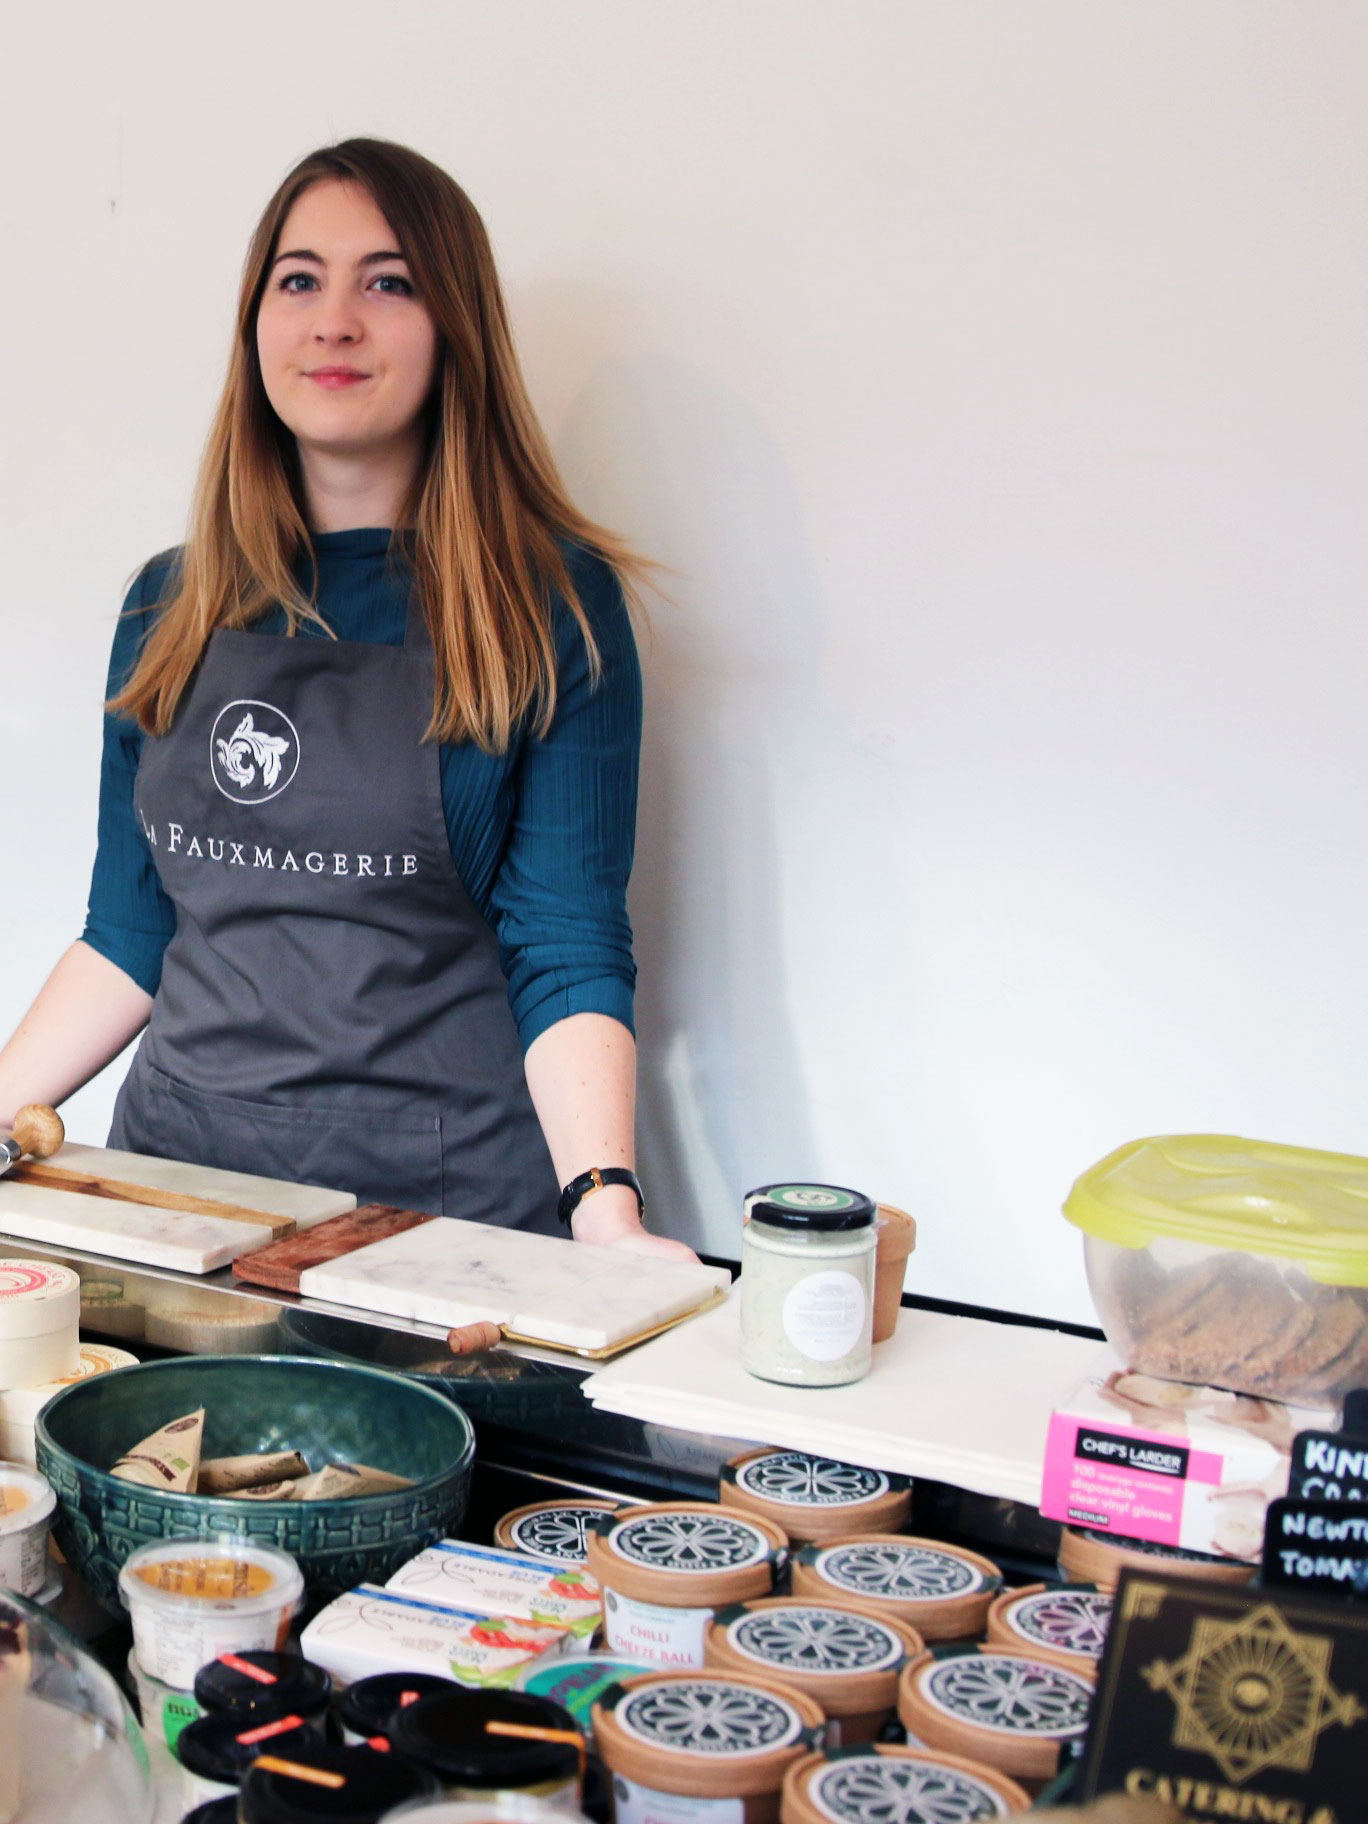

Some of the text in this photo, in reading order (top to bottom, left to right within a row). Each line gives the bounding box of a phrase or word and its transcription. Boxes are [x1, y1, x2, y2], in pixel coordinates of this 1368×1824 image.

[167, 822, 419, 878] FAUXMAGERIE
[1082, 1437, 1182, 1470] CHEF'S LARDER
[1074, 1463, 1096, 1478] 100
[1070, 1478, 1136, 1501] disposable
[1068, 1508, 1109, 1525] MEDIUM
[1069, 1492, 1173, 1524] clear vinyl gloves
[1282, 1511, 1368, 1542] NEWT
[614, 1632, 695, 1665] CHEEZE BALL
[630, 1623, 670, 1644] CHILLI
[1124, 1768, 1306, 1824] CATERING
